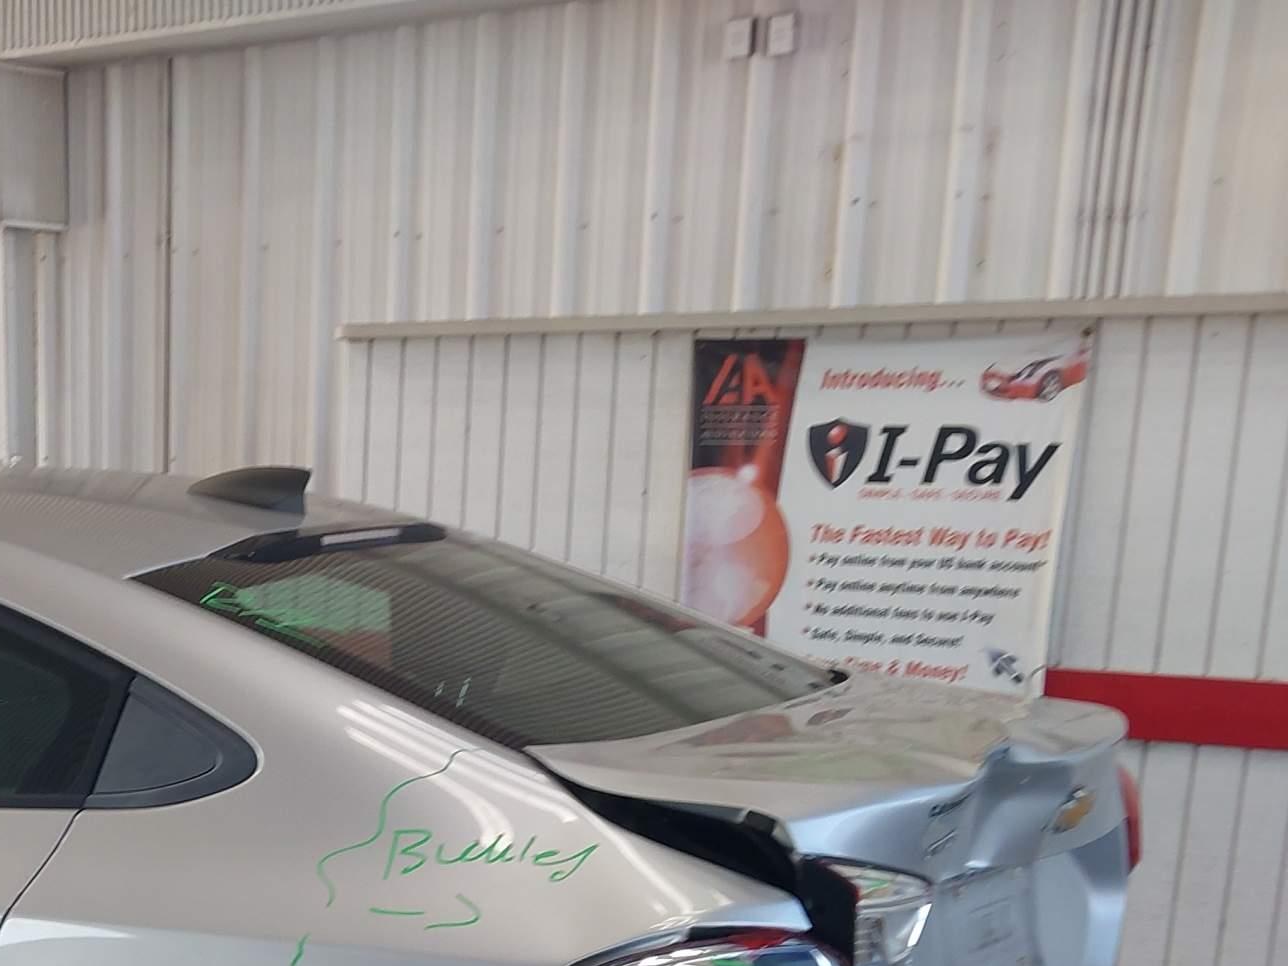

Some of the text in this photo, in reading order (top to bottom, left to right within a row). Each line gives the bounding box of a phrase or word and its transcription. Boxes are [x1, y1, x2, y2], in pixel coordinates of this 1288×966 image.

[819, 367, 966, 392] Introducing...
[866, 425, 1062, 501] I-Pay
[811, 523, 1052, 554] The Fastest Way to Pay!
[816, 552, 840, 568] Pay
[842, 554, 876, 567] online
[877, 554, 906, 568] from
[815, 577, 839, 593] Pay
[904, 660, 969, 684] Money!
